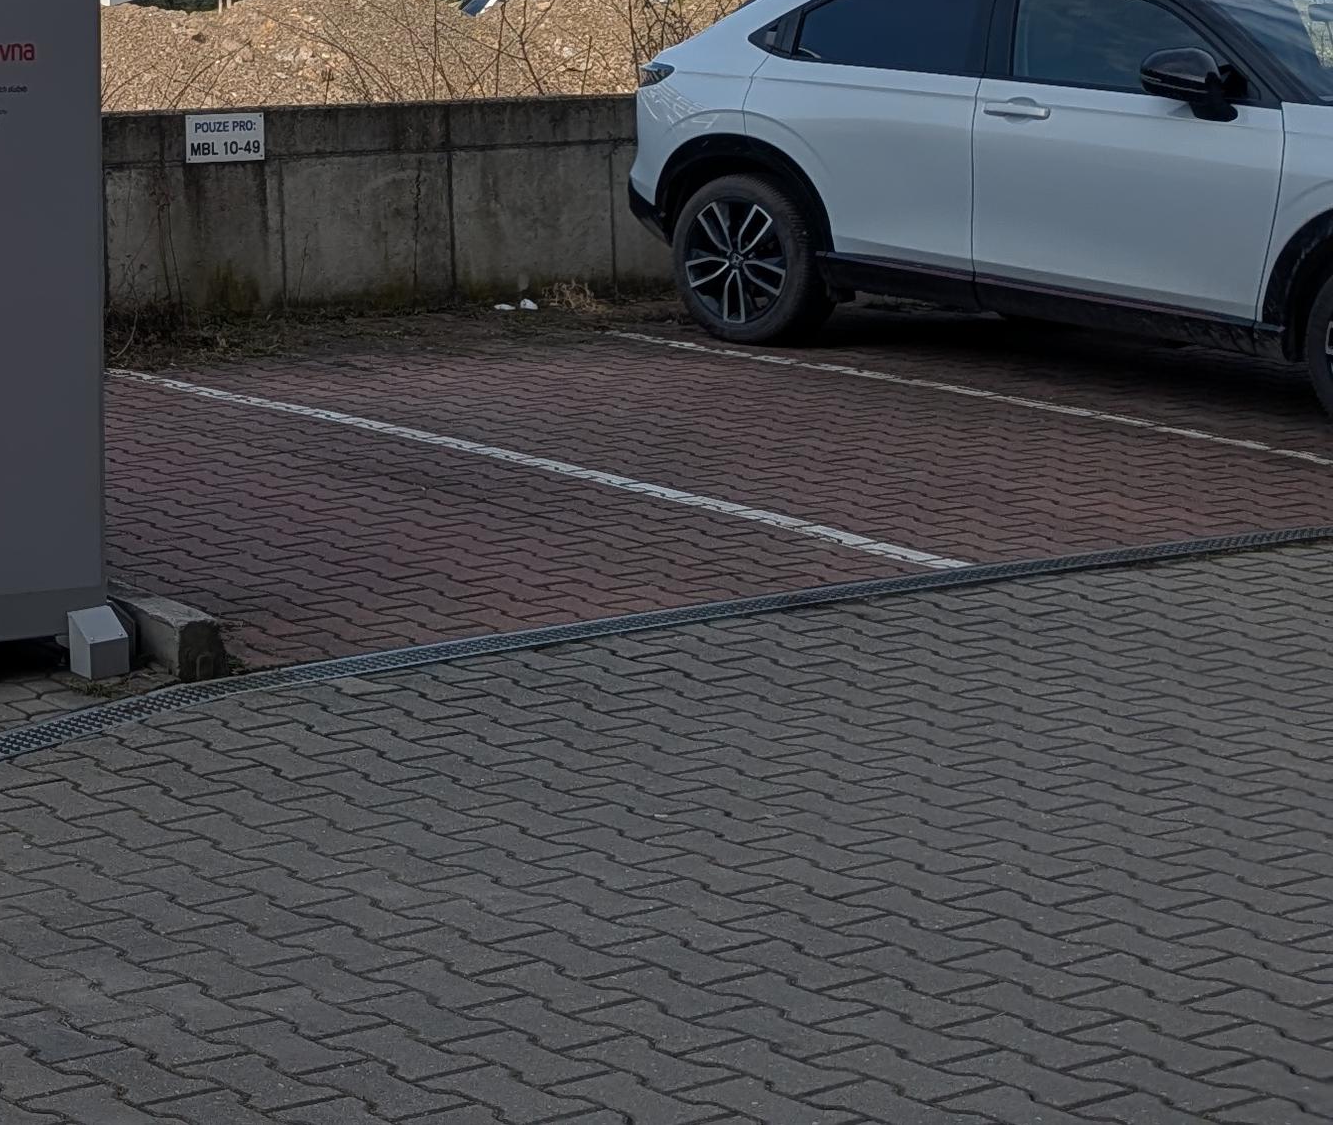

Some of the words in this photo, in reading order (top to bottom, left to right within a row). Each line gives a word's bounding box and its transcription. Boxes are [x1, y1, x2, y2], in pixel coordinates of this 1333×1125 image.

[194, 121, 230, 133] POUZE
[232, 120, 257, 131] PRO:
[190, 142, 219, 156] MBL
[223, 140, 261, 155] 10-49
